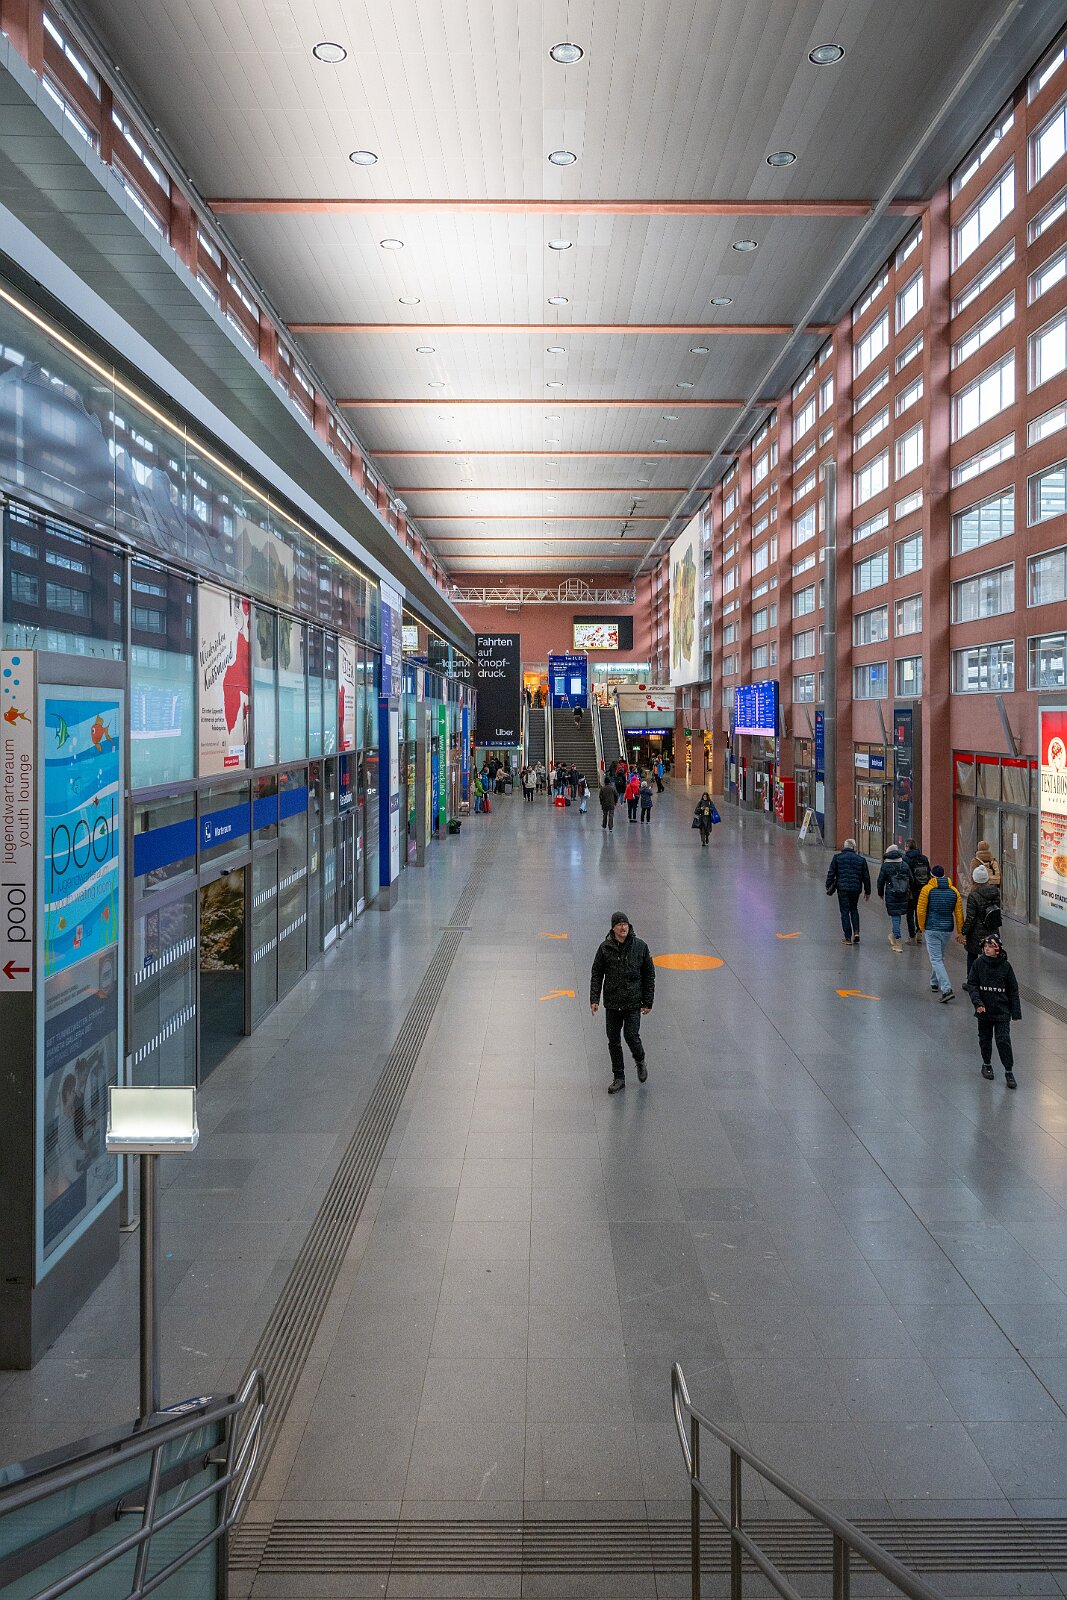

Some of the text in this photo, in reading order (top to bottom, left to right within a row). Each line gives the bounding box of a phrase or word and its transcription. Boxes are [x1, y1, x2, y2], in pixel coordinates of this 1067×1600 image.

[477, 637, 513, 646] Fahrten
[477, 647, 493, 657] auf
[477, 658, 511, 669] Knopf-
[477, 668, 507, 678] druck.
[495, 728, 514, 736] Uber
[2, 739, 17, 865] jugendwarteraum
[17, 753, 32, 848] youth lounge
[51, 797, 114, 894] pool
[1, 883, 32, 943] pool
